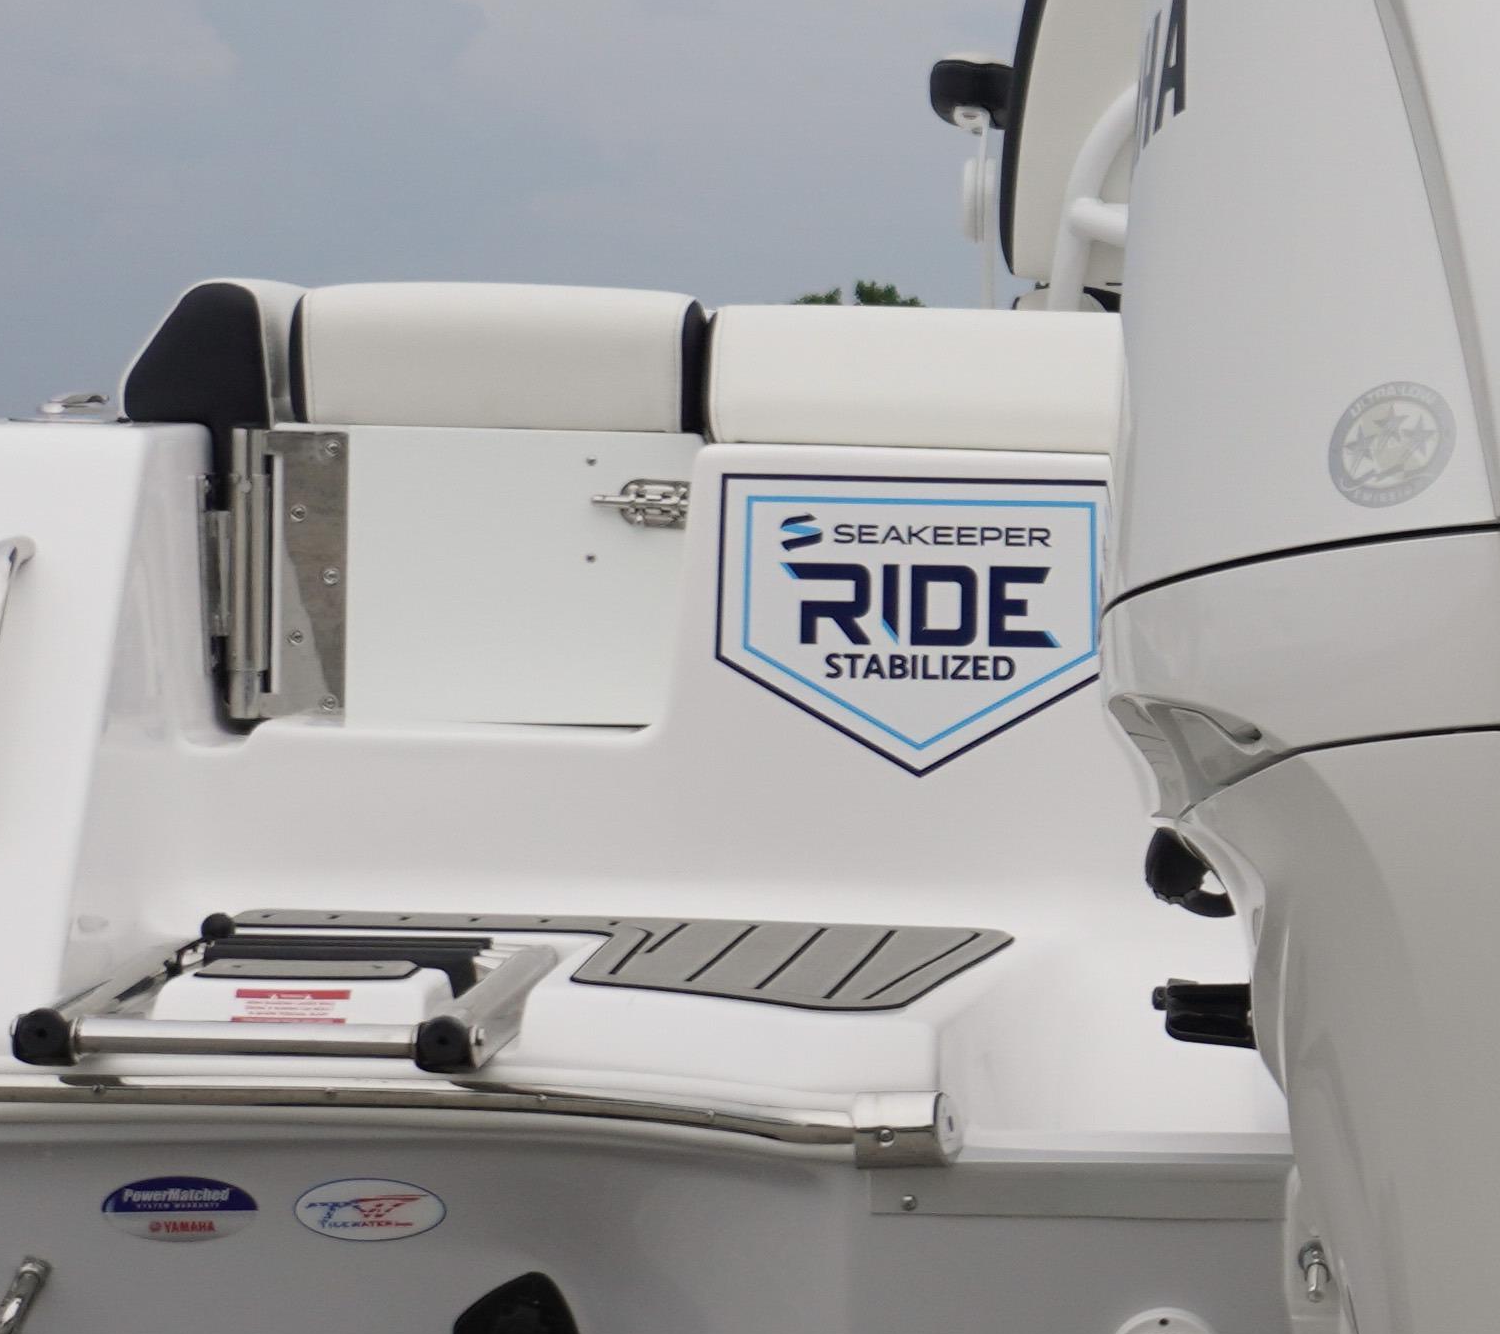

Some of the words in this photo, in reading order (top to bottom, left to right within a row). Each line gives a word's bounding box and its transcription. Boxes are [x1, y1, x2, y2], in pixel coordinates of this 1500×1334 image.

[833, 523, 1052, 548] SEAKEEPER
[780, 561, 1062, 648] RIDE
[824, 653, 1016, 681] STABILIZED
[122, 1187, 231, 1203] PowerMatched
[163, 1220, 216, 1234] YAMAHA
